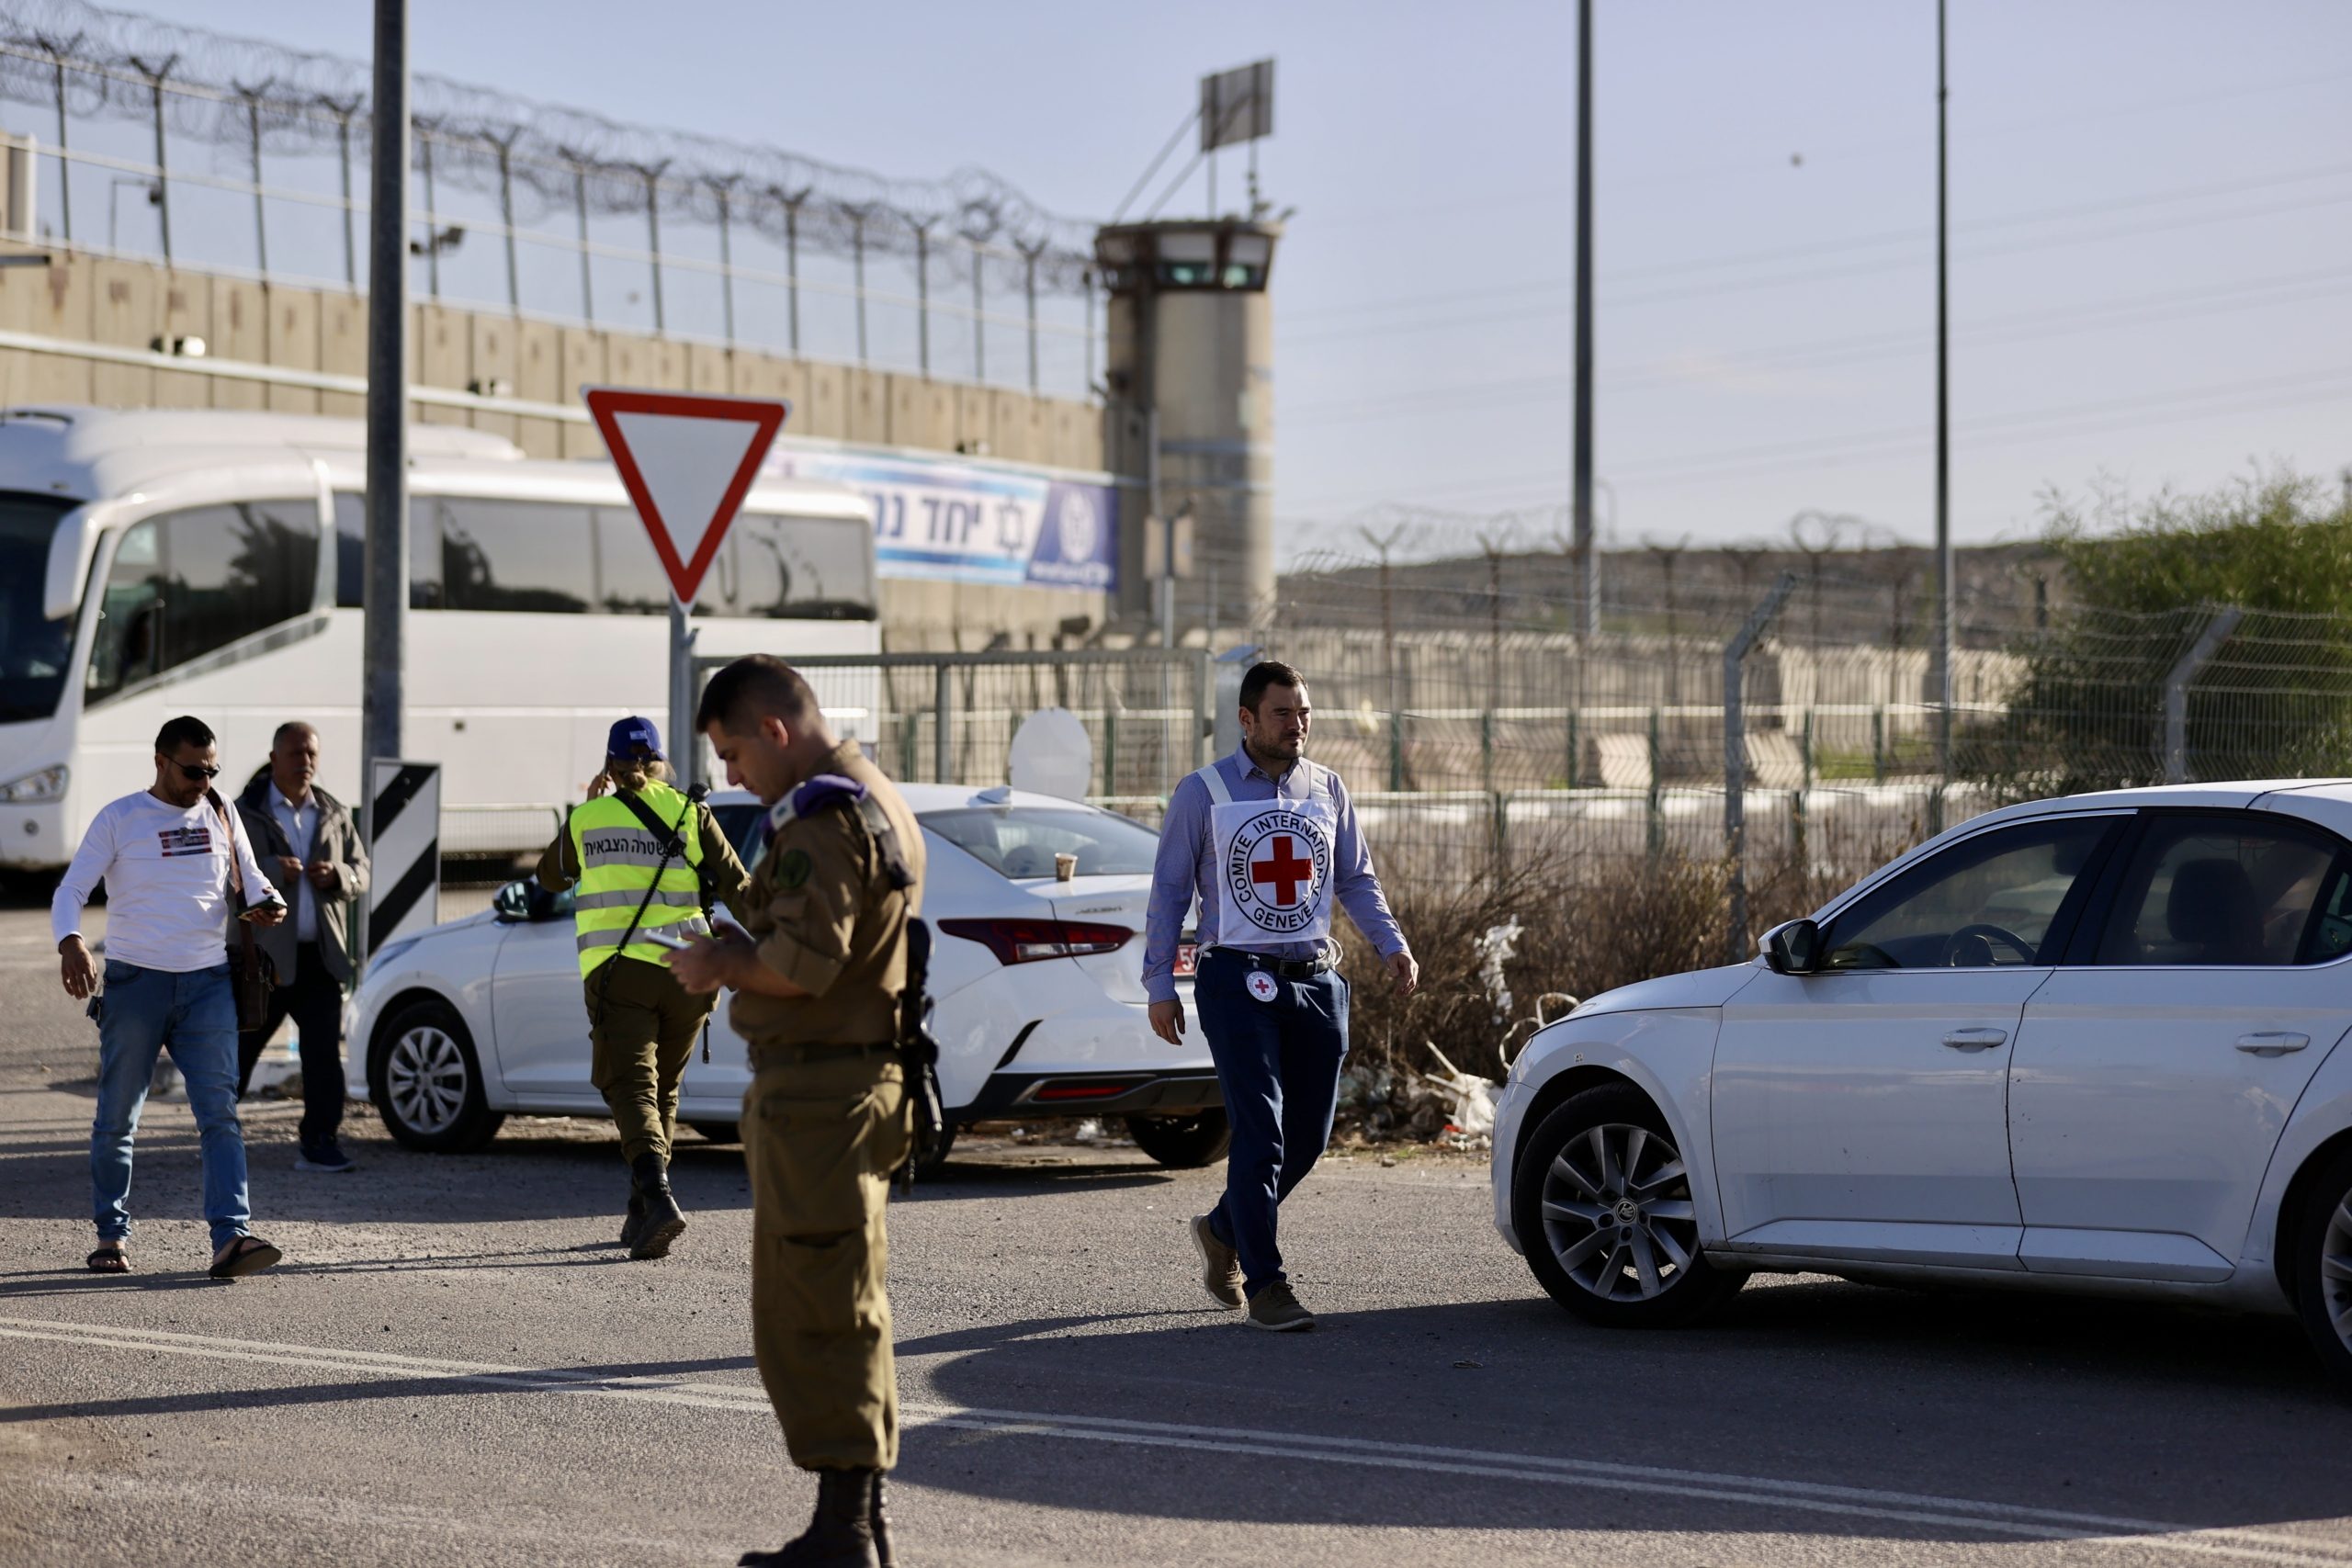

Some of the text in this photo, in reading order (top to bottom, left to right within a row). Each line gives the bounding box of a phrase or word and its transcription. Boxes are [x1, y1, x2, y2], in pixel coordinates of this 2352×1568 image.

[922, 497, 980, 543] יחד
[583, 838, 628, 856] הצבאית
[1232, 834, 1252, 903] COMITE
[1253, 905, 1314, 929] GENEVE
